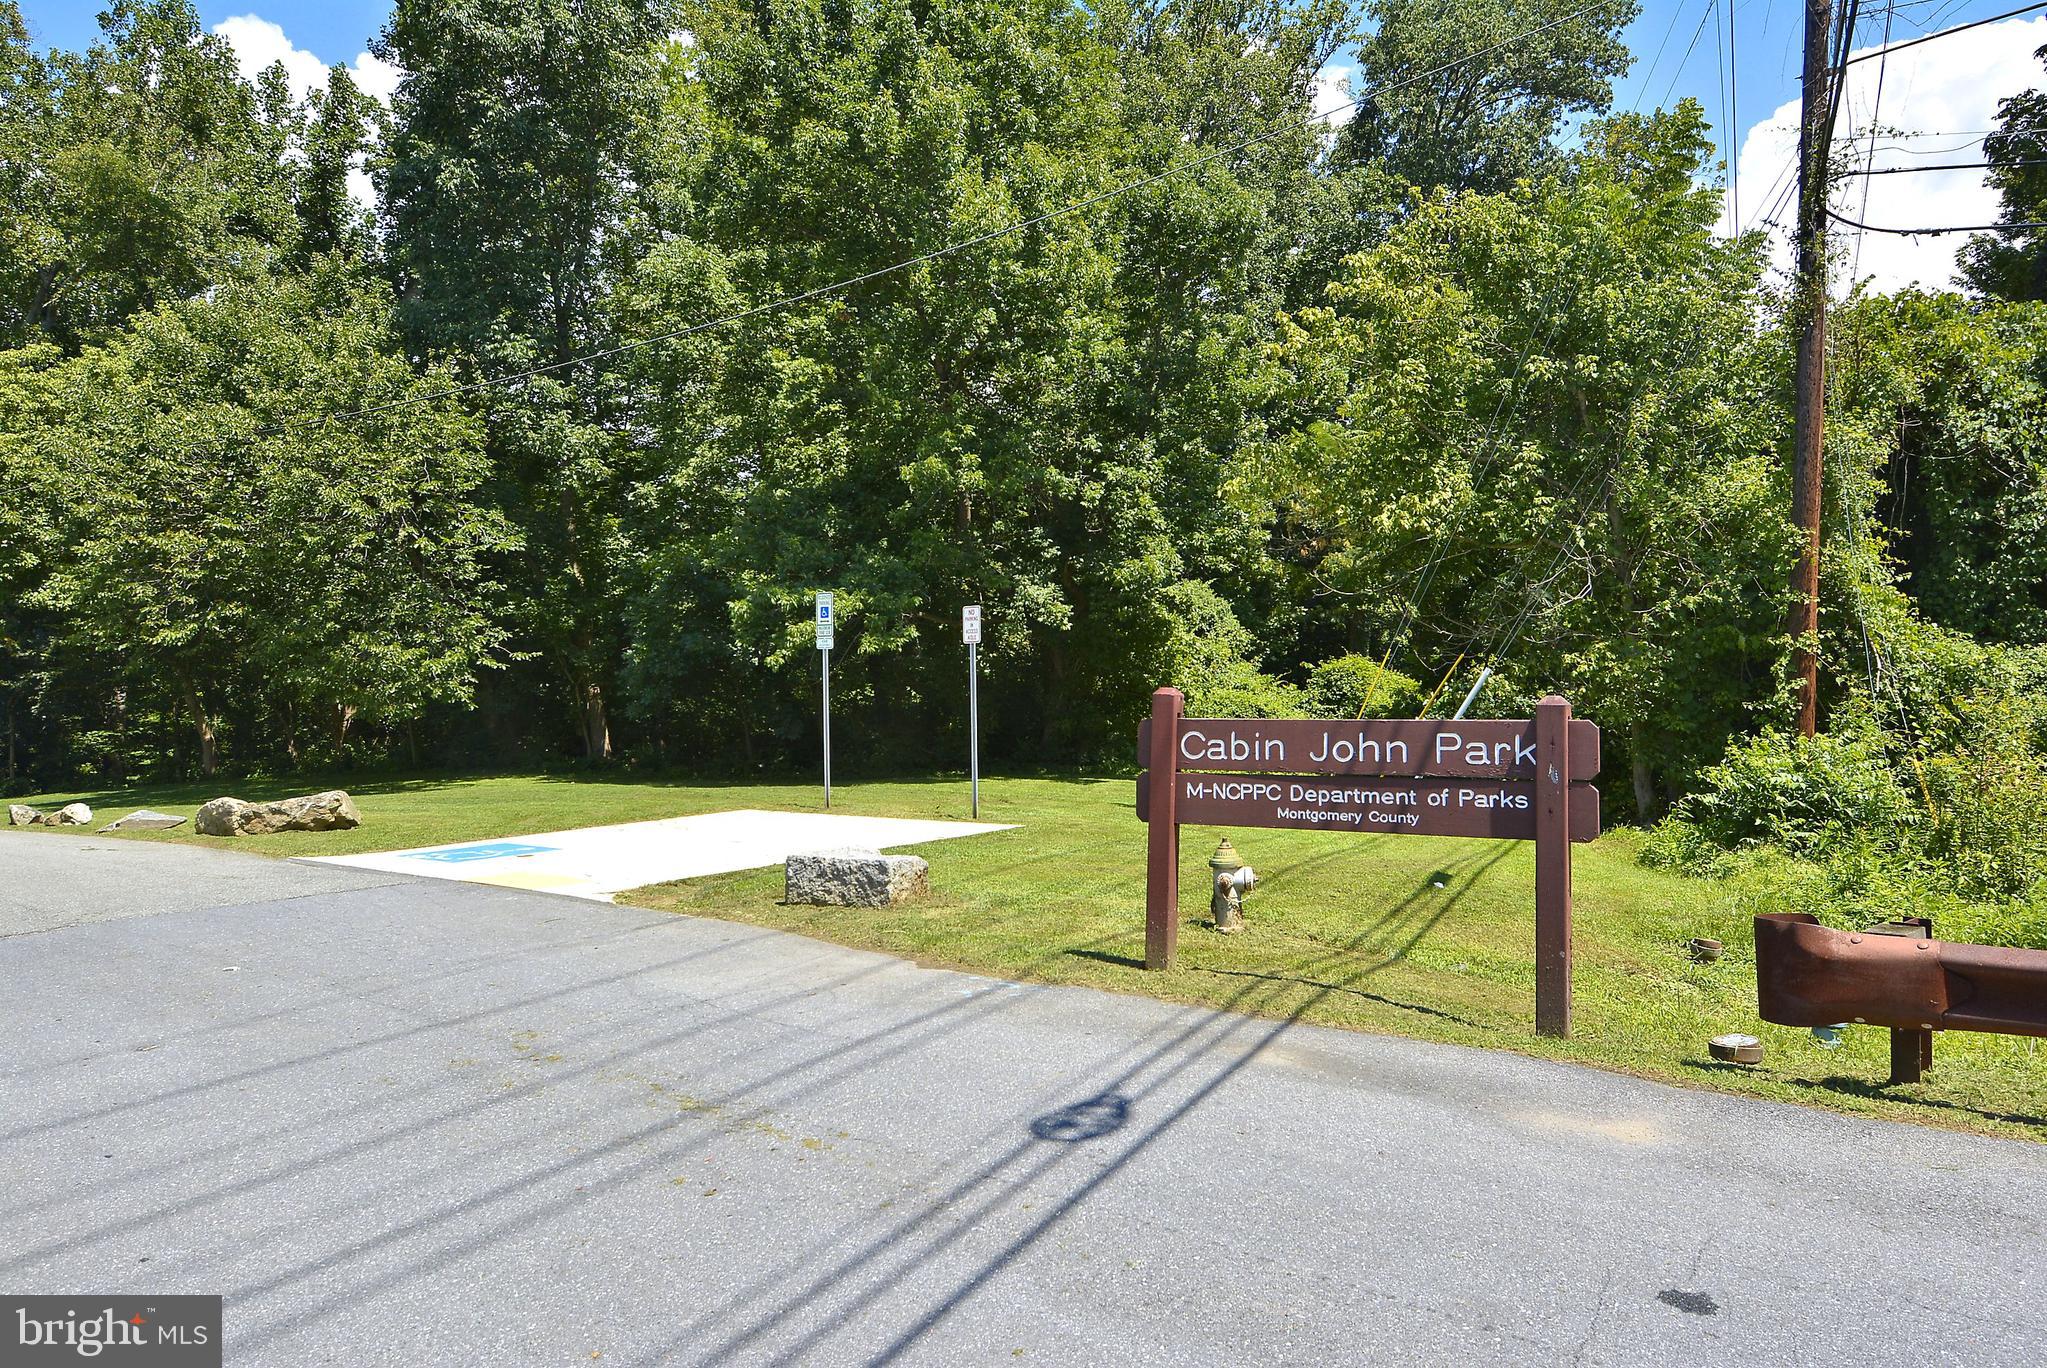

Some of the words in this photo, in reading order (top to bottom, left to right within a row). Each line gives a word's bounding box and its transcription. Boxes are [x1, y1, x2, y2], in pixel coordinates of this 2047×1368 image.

[1180, 730, 1285, 761] Cabin
[1309, 731, 1408, 764] John
[1435, 732, 1537, 766] Park
[1186, 781, 1282, 801] M-NCPPC
[1289, 784, 1417, 807] Department
[1427, 787, 1449, 807] of
[1458, 788, 1529, 809] Parks
[1277, 806, 1363, 825] Montgomery
[1368, 810, 1420, 827] County
